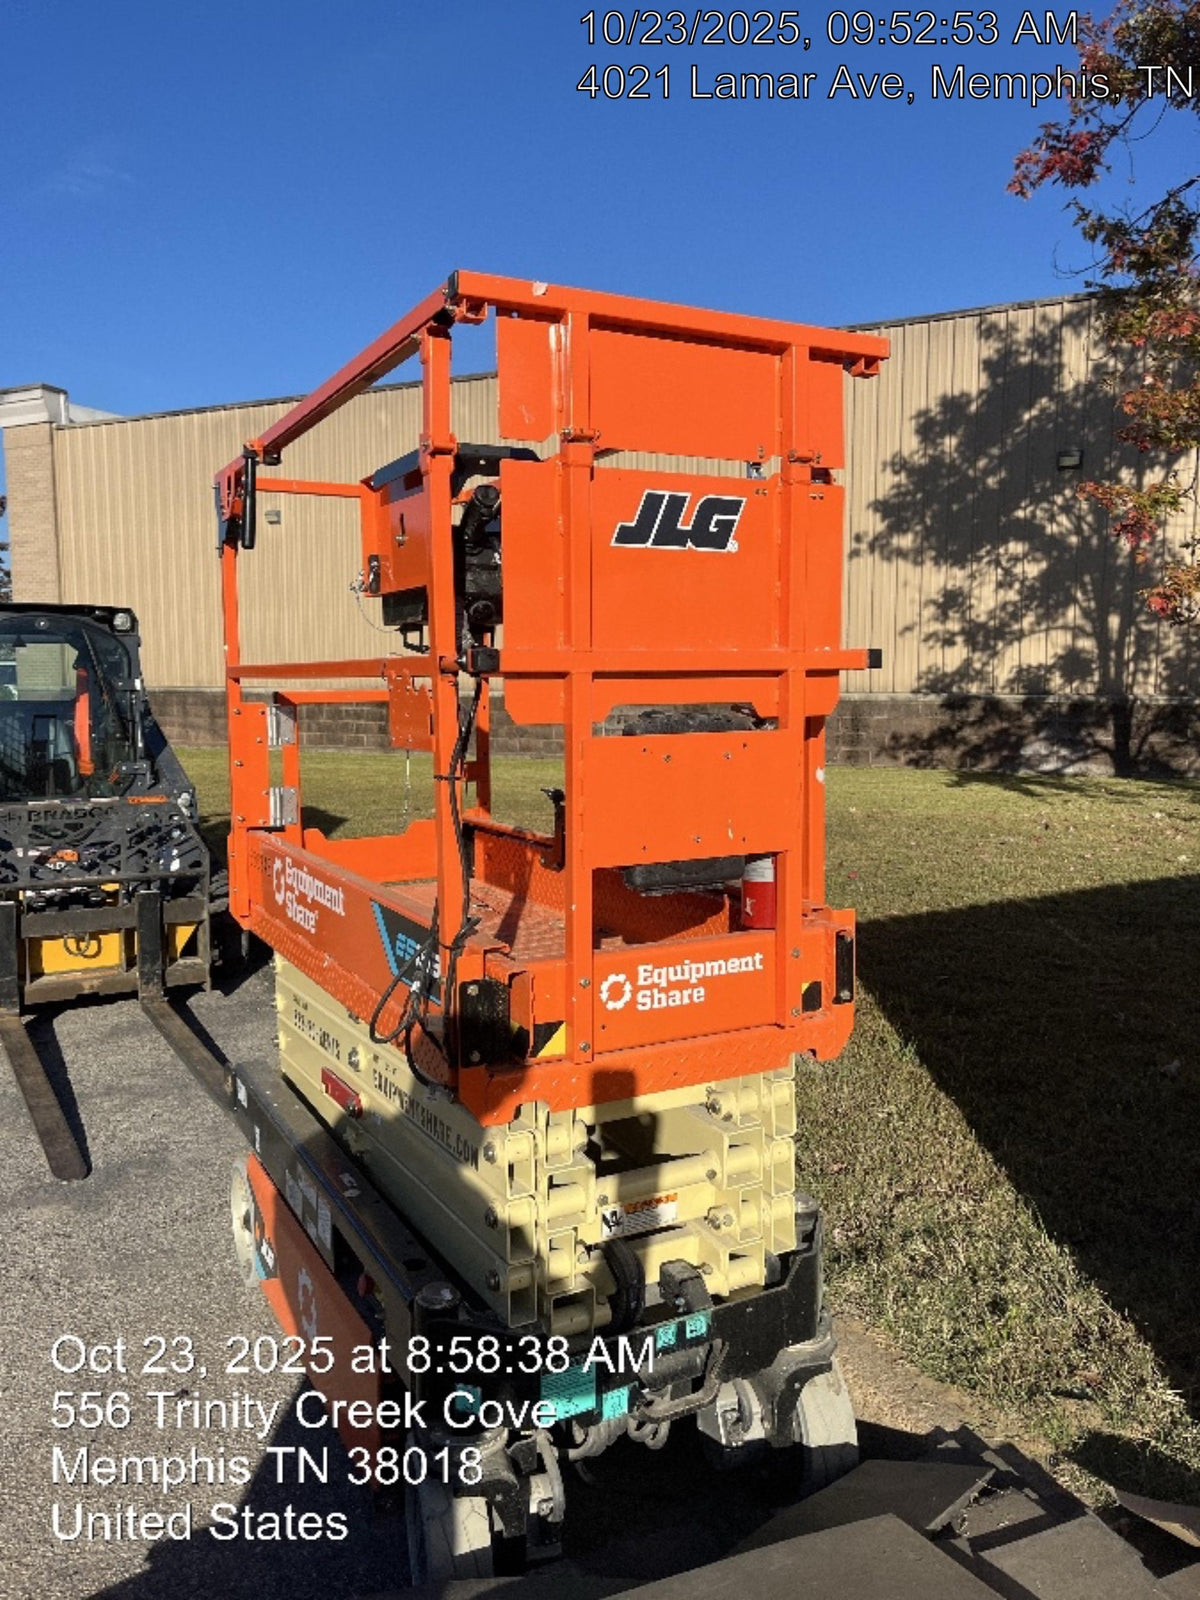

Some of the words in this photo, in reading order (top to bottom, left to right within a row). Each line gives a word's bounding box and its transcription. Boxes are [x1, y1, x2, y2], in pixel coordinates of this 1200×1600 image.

[610, 488, 747, 553] JLG
[285, 856, 345, 916] Equipment
[285, 892, 316, 934] Share
[637, 952, 763, 987] Equipment
[636, 986, 705, 1011] Share
